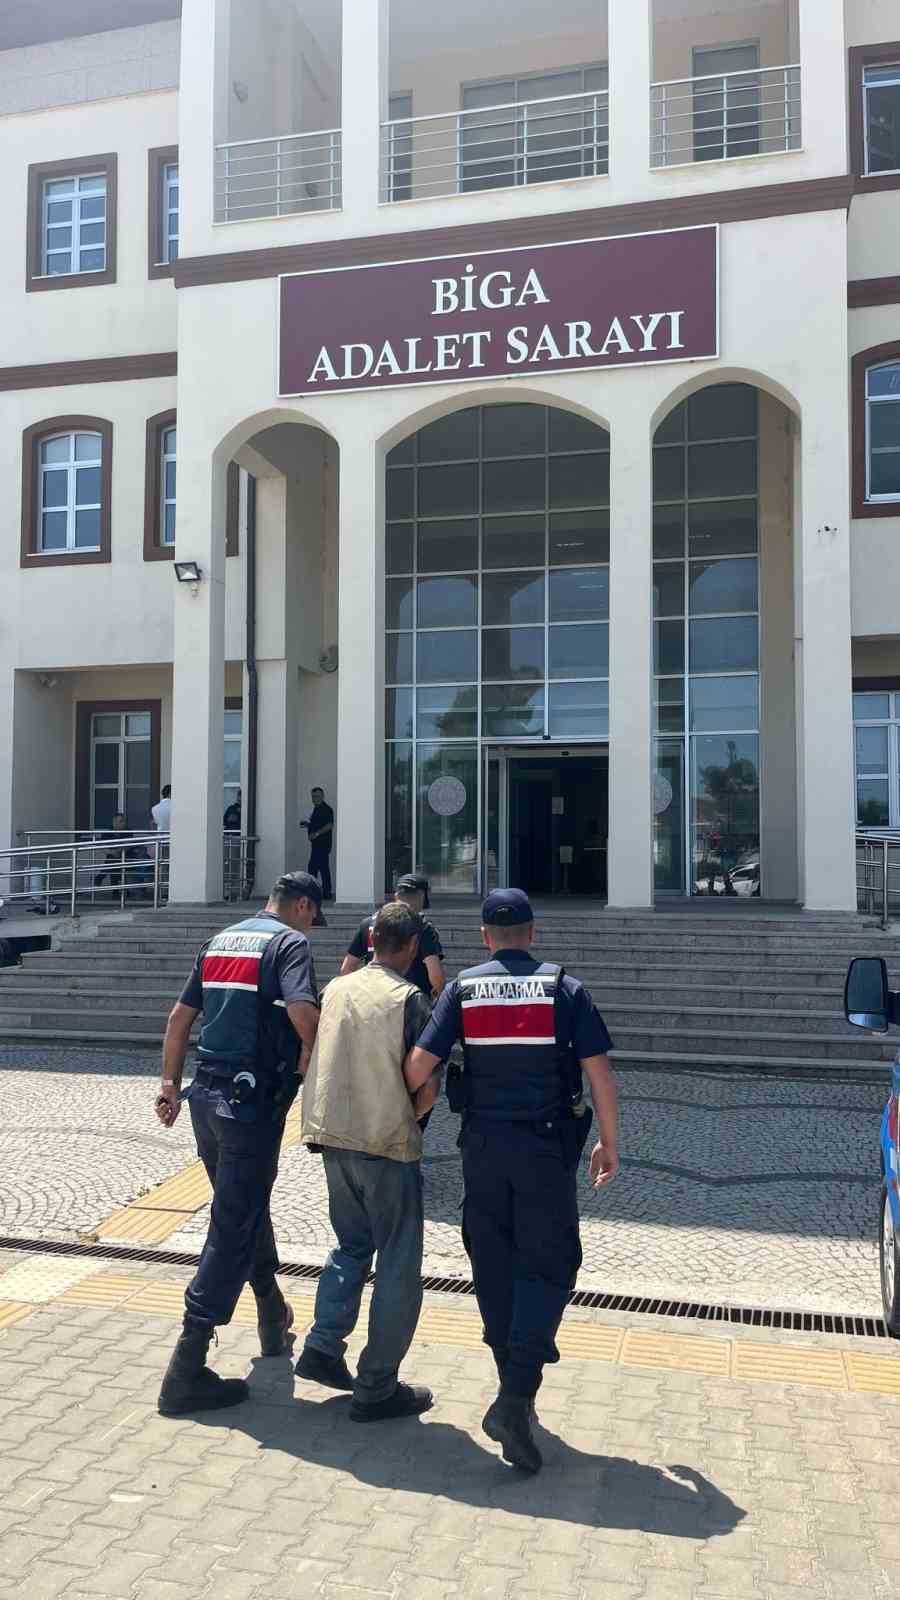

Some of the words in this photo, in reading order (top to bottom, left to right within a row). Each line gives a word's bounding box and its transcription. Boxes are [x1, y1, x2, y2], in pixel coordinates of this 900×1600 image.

[432, 264, 550, 315] BİGA
[307, 331, 491, 383] ADALET
[506, 311, 685, 364] SARAYI
[470, 981, 546, 999] JANDARMA
